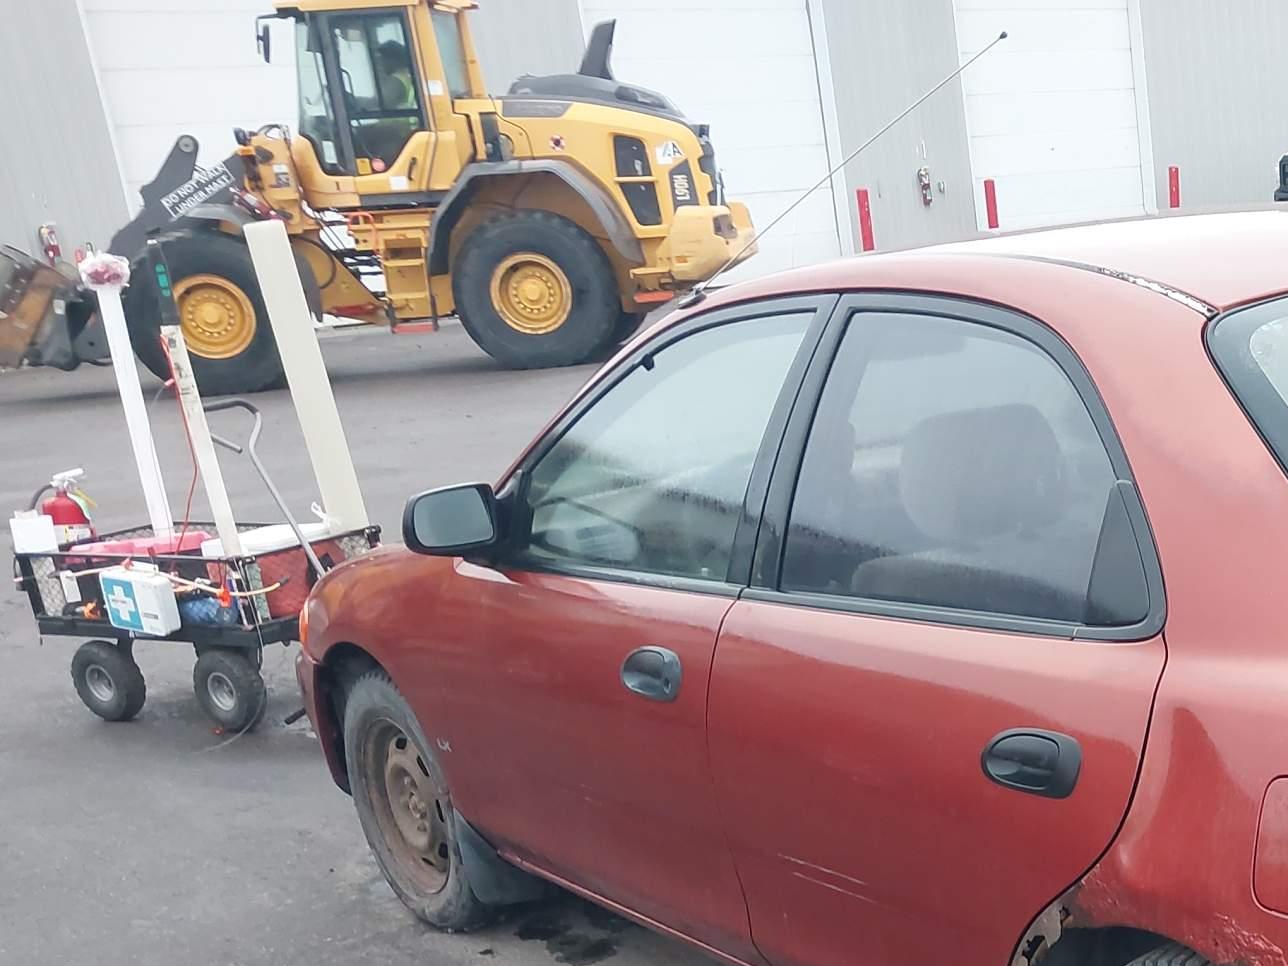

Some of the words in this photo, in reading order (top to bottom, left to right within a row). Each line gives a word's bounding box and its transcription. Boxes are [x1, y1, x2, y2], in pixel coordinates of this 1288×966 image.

[161, 193, 180, 208] DO
[177, 181, 200, 199] NOT
[174, 190, 209, 214] UNDER
[204, 174, 231, 195] MAST
